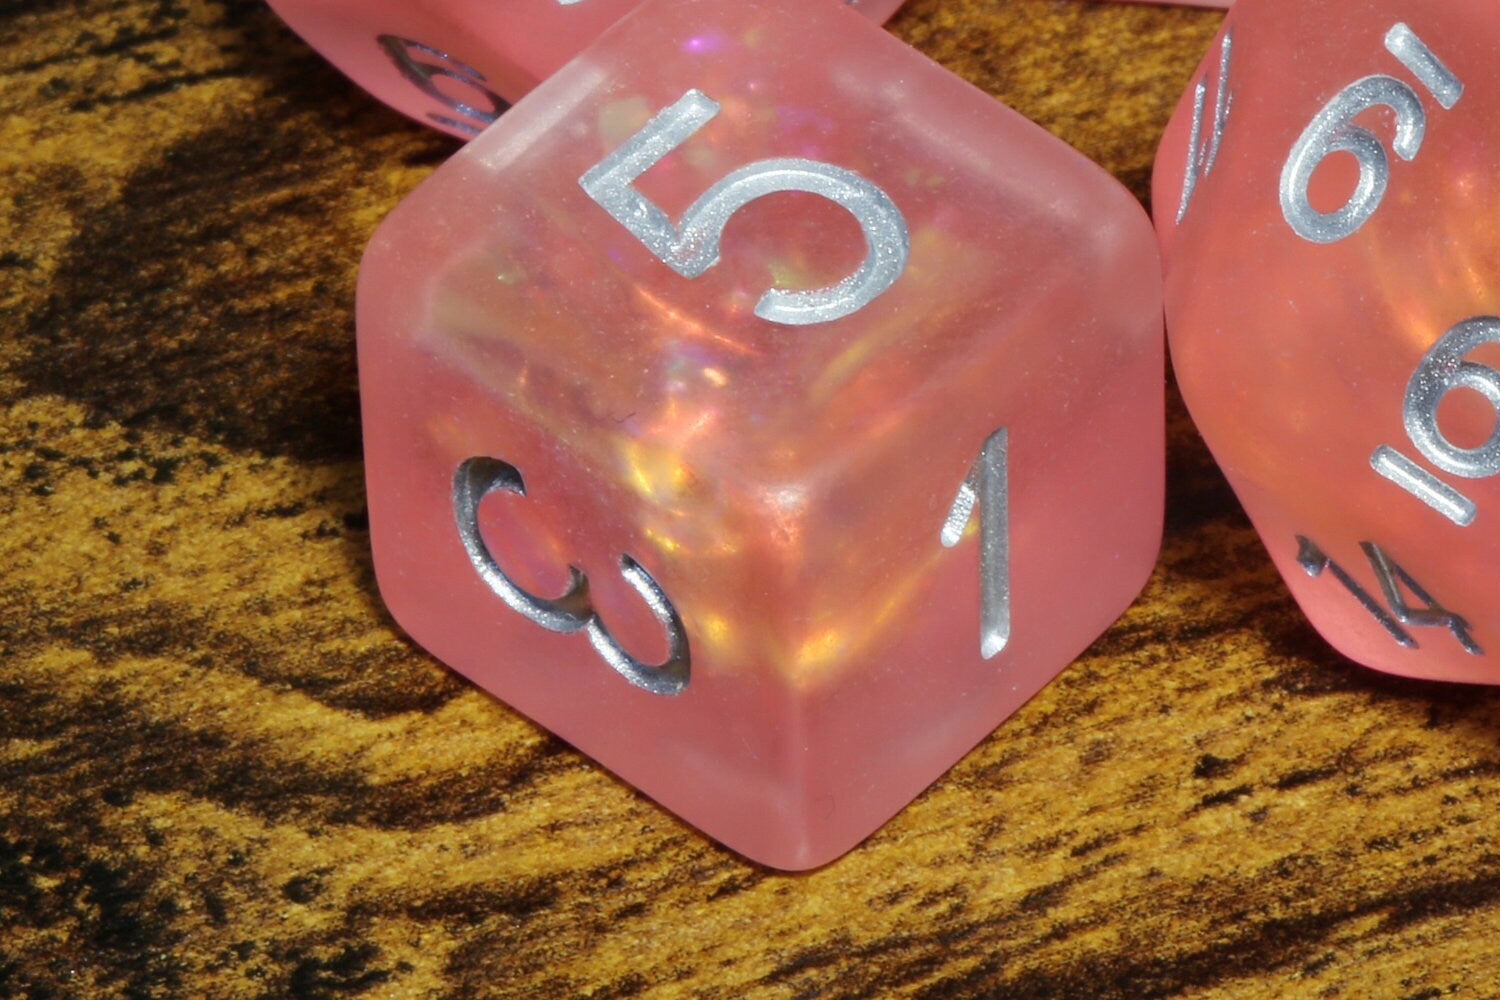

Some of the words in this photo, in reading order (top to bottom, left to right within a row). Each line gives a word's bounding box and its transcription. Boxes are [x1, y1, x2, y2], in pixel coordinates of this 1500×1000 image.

[579, 88, 909, 325] 5
[451, 456, 690, 696] 3
[941, 425, 1010, 660] 1
[1296, 534, 1485, 656] 14
